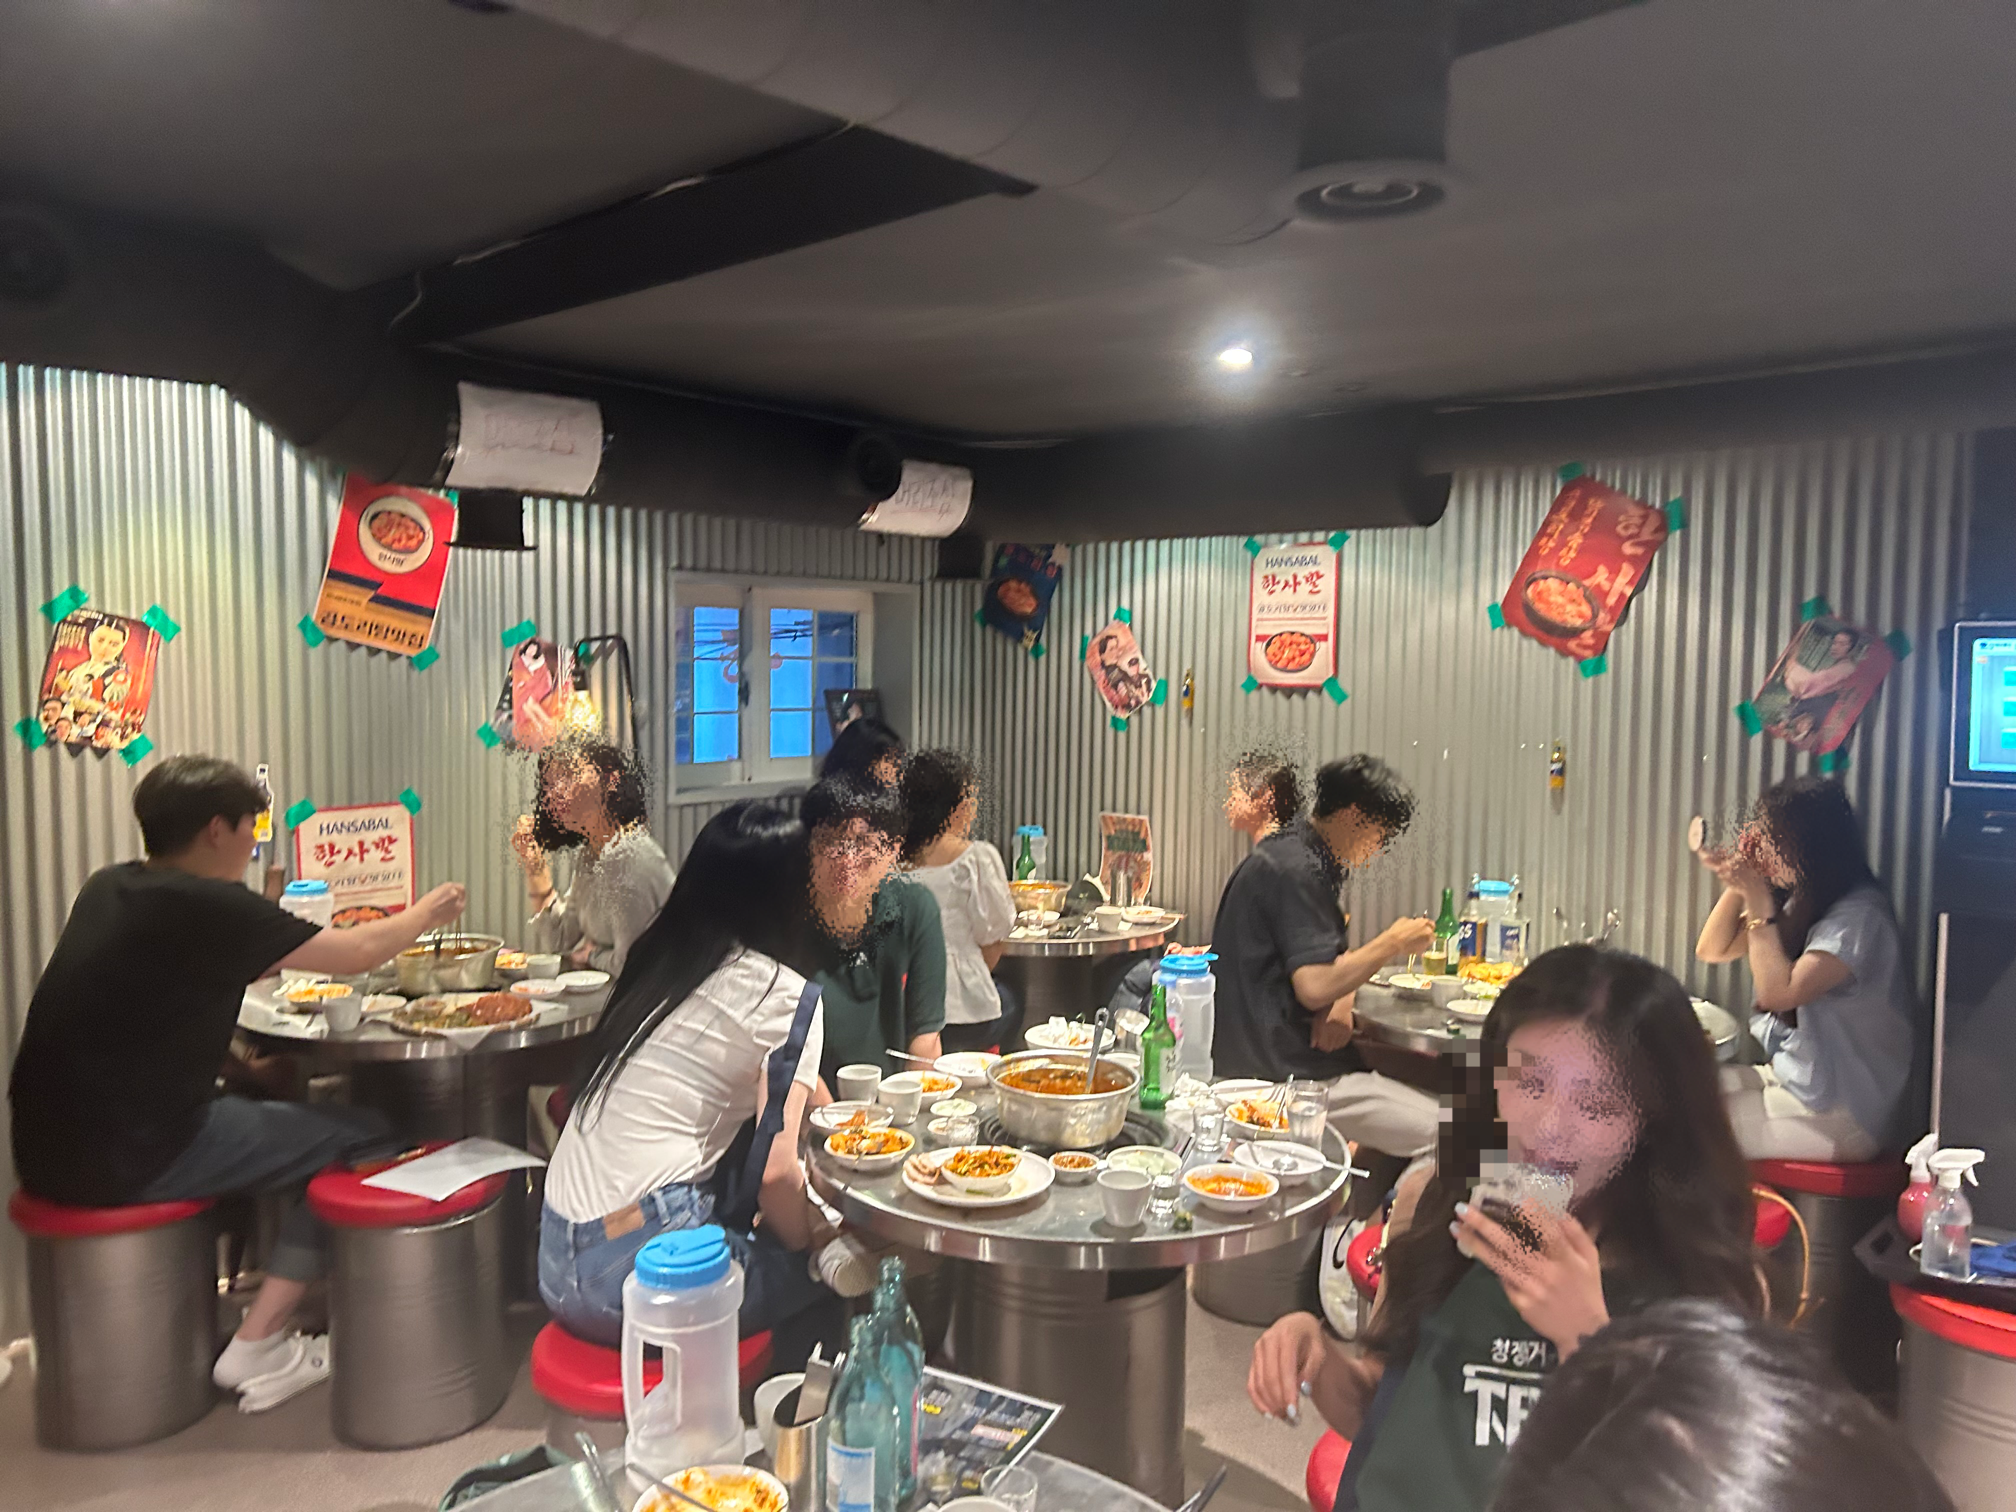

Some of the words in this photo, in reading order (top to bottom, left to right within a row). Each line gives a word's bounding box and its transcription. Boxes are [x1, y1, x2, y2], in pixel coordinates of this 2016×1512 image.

[1265, 554, 1321, 569] HANSABAL
[1262, 570, 1325, 596] 한사발
[319, 817, 392, 836] HANSABAL
[314, 834, 398, 868] 한사발
